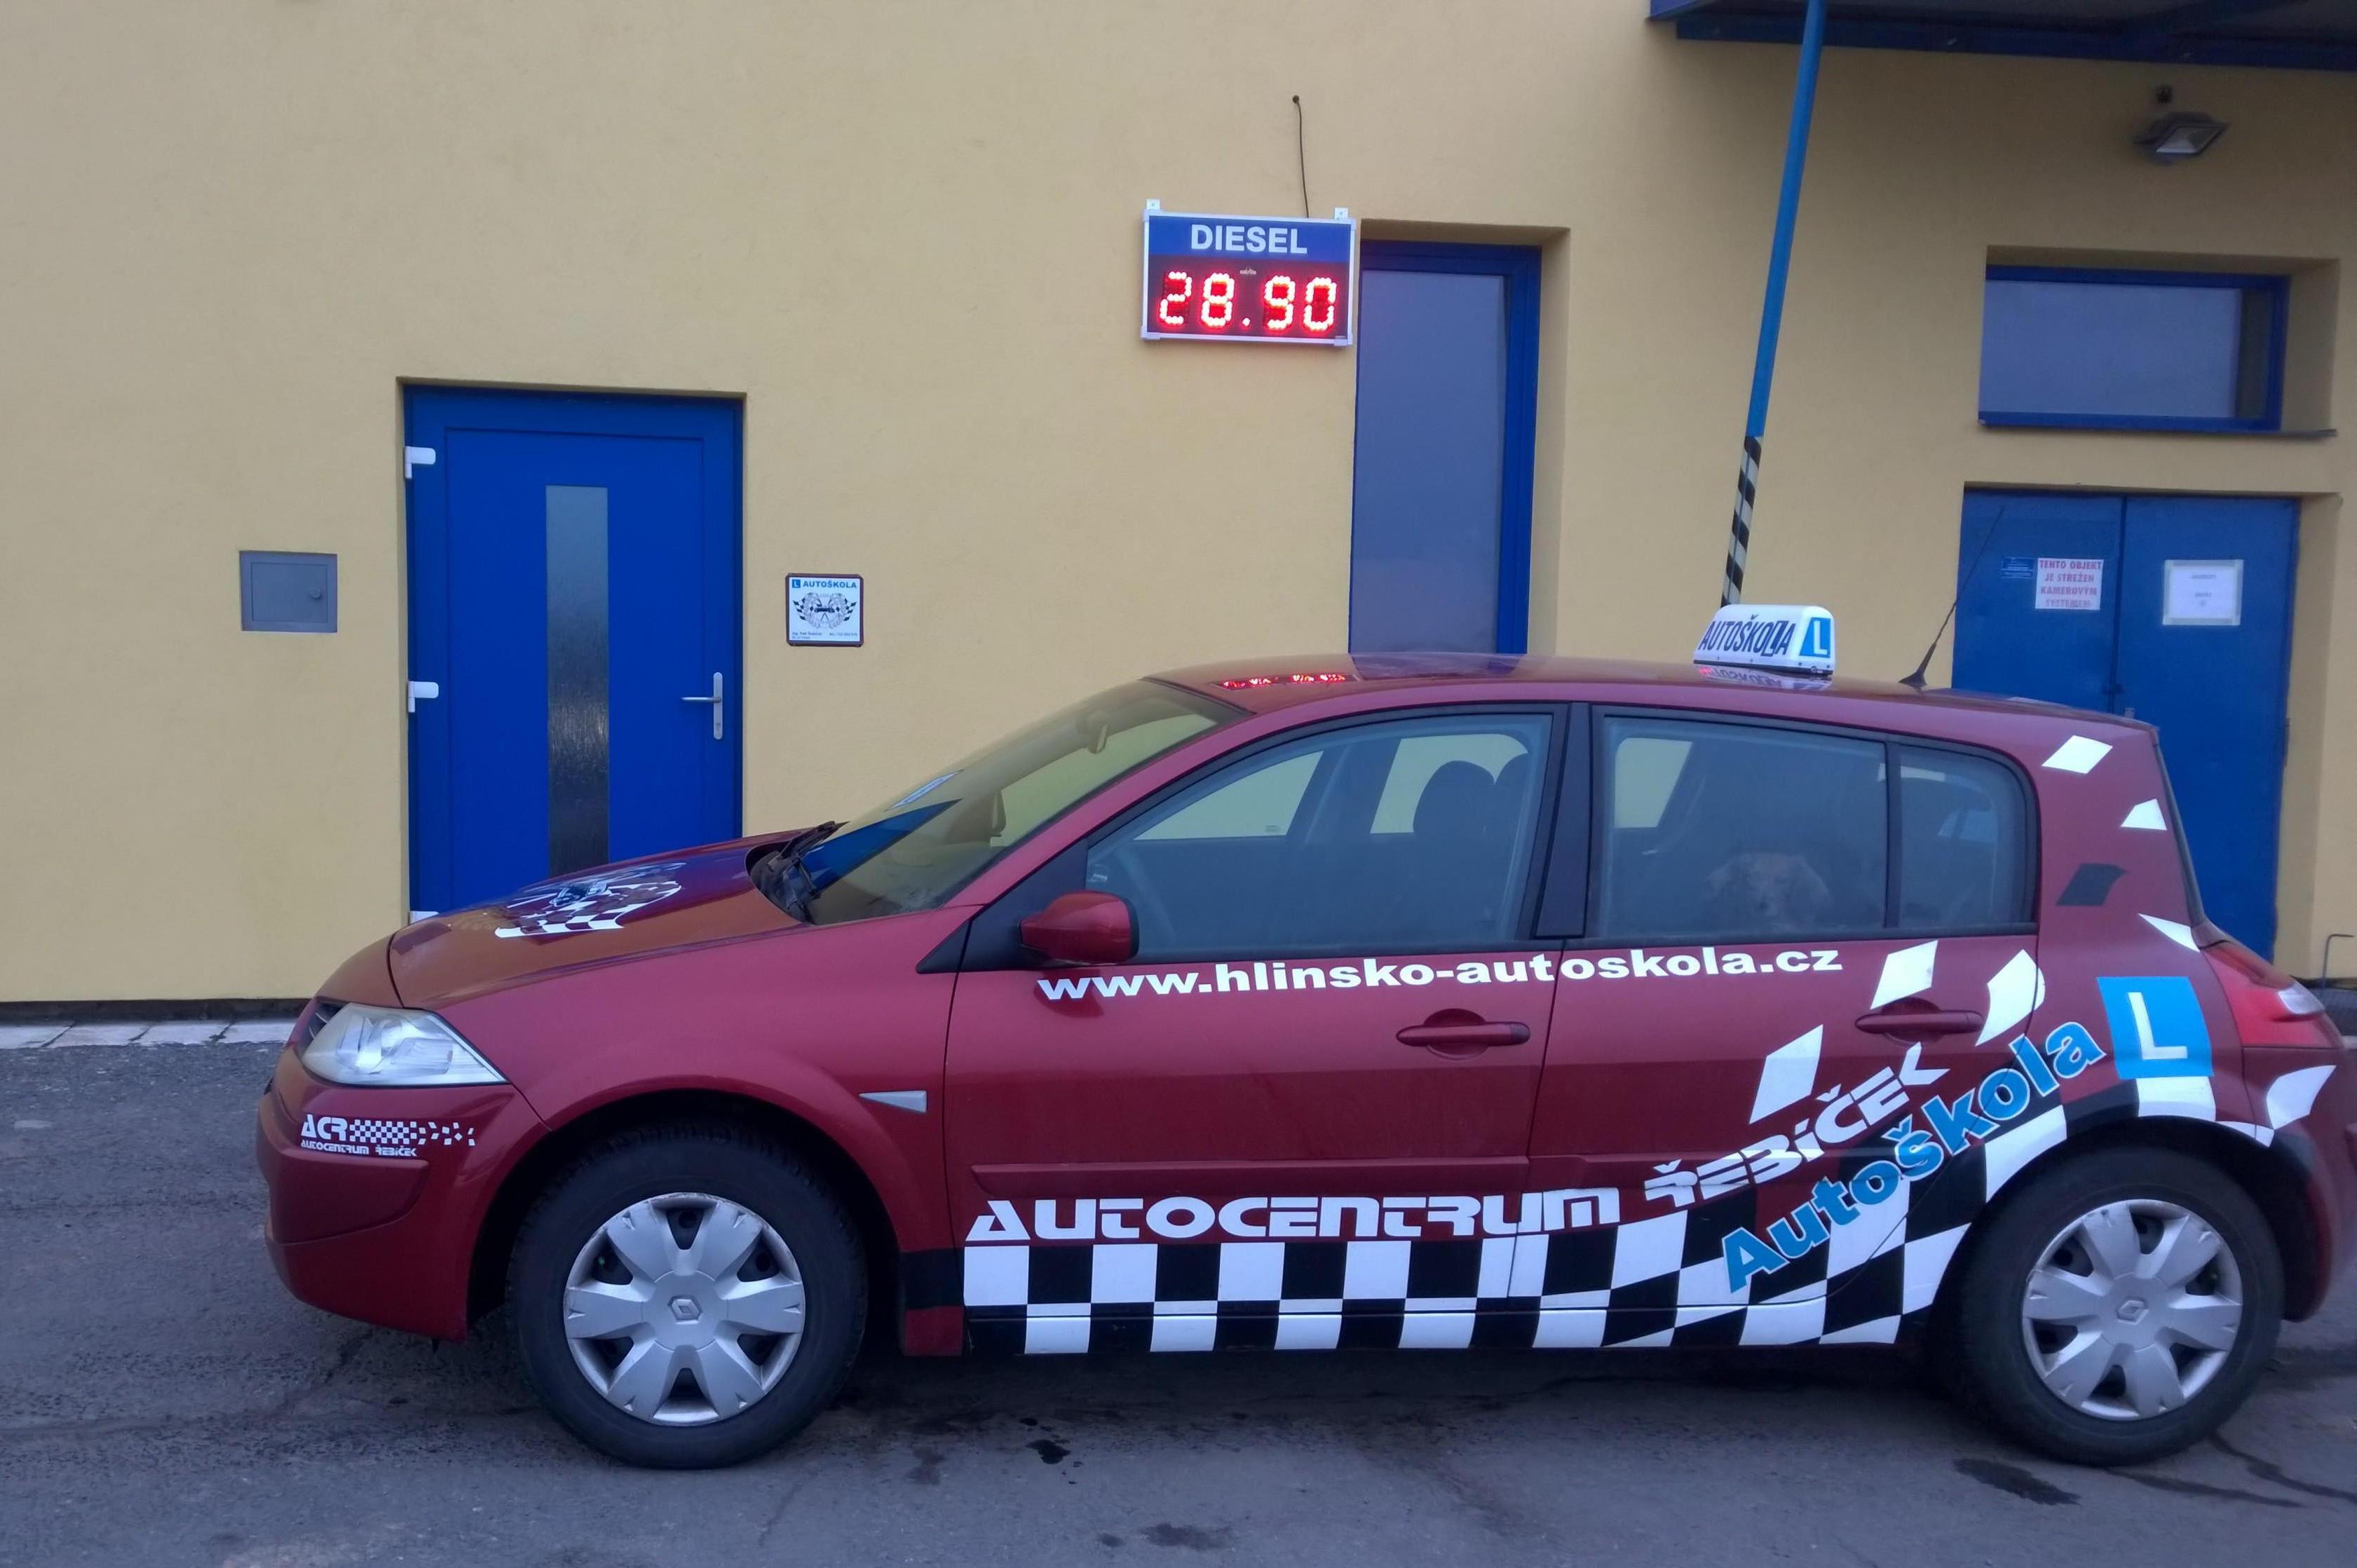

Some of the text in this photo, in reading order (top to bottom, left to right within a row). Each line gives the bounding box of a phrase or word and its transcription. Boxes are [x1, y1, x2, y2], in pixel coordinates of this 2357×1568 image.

[1191, 224, 1307, 254] DIESEL
[1159, 271, 1337, 331] 28.90
[2039, 559, 2067, 569] TENTO
[2070, 560, 2103, 570] OBJEKT
[2044, 573, 2053, 582] JE
[803, 580, 857, 589] AUTOŠKOLA
[1697, 614, 1828, 657] AUTOŠKOLA L
[1037, 946, 1843, 1000] www.hlinsko-autoskola.cz
[301, 1114, 348, 1141] ACR
[1721, 992, 2188, 1294] Autoškola L
[965, 1186, 1620, 1241] AUTOCENTRUM
